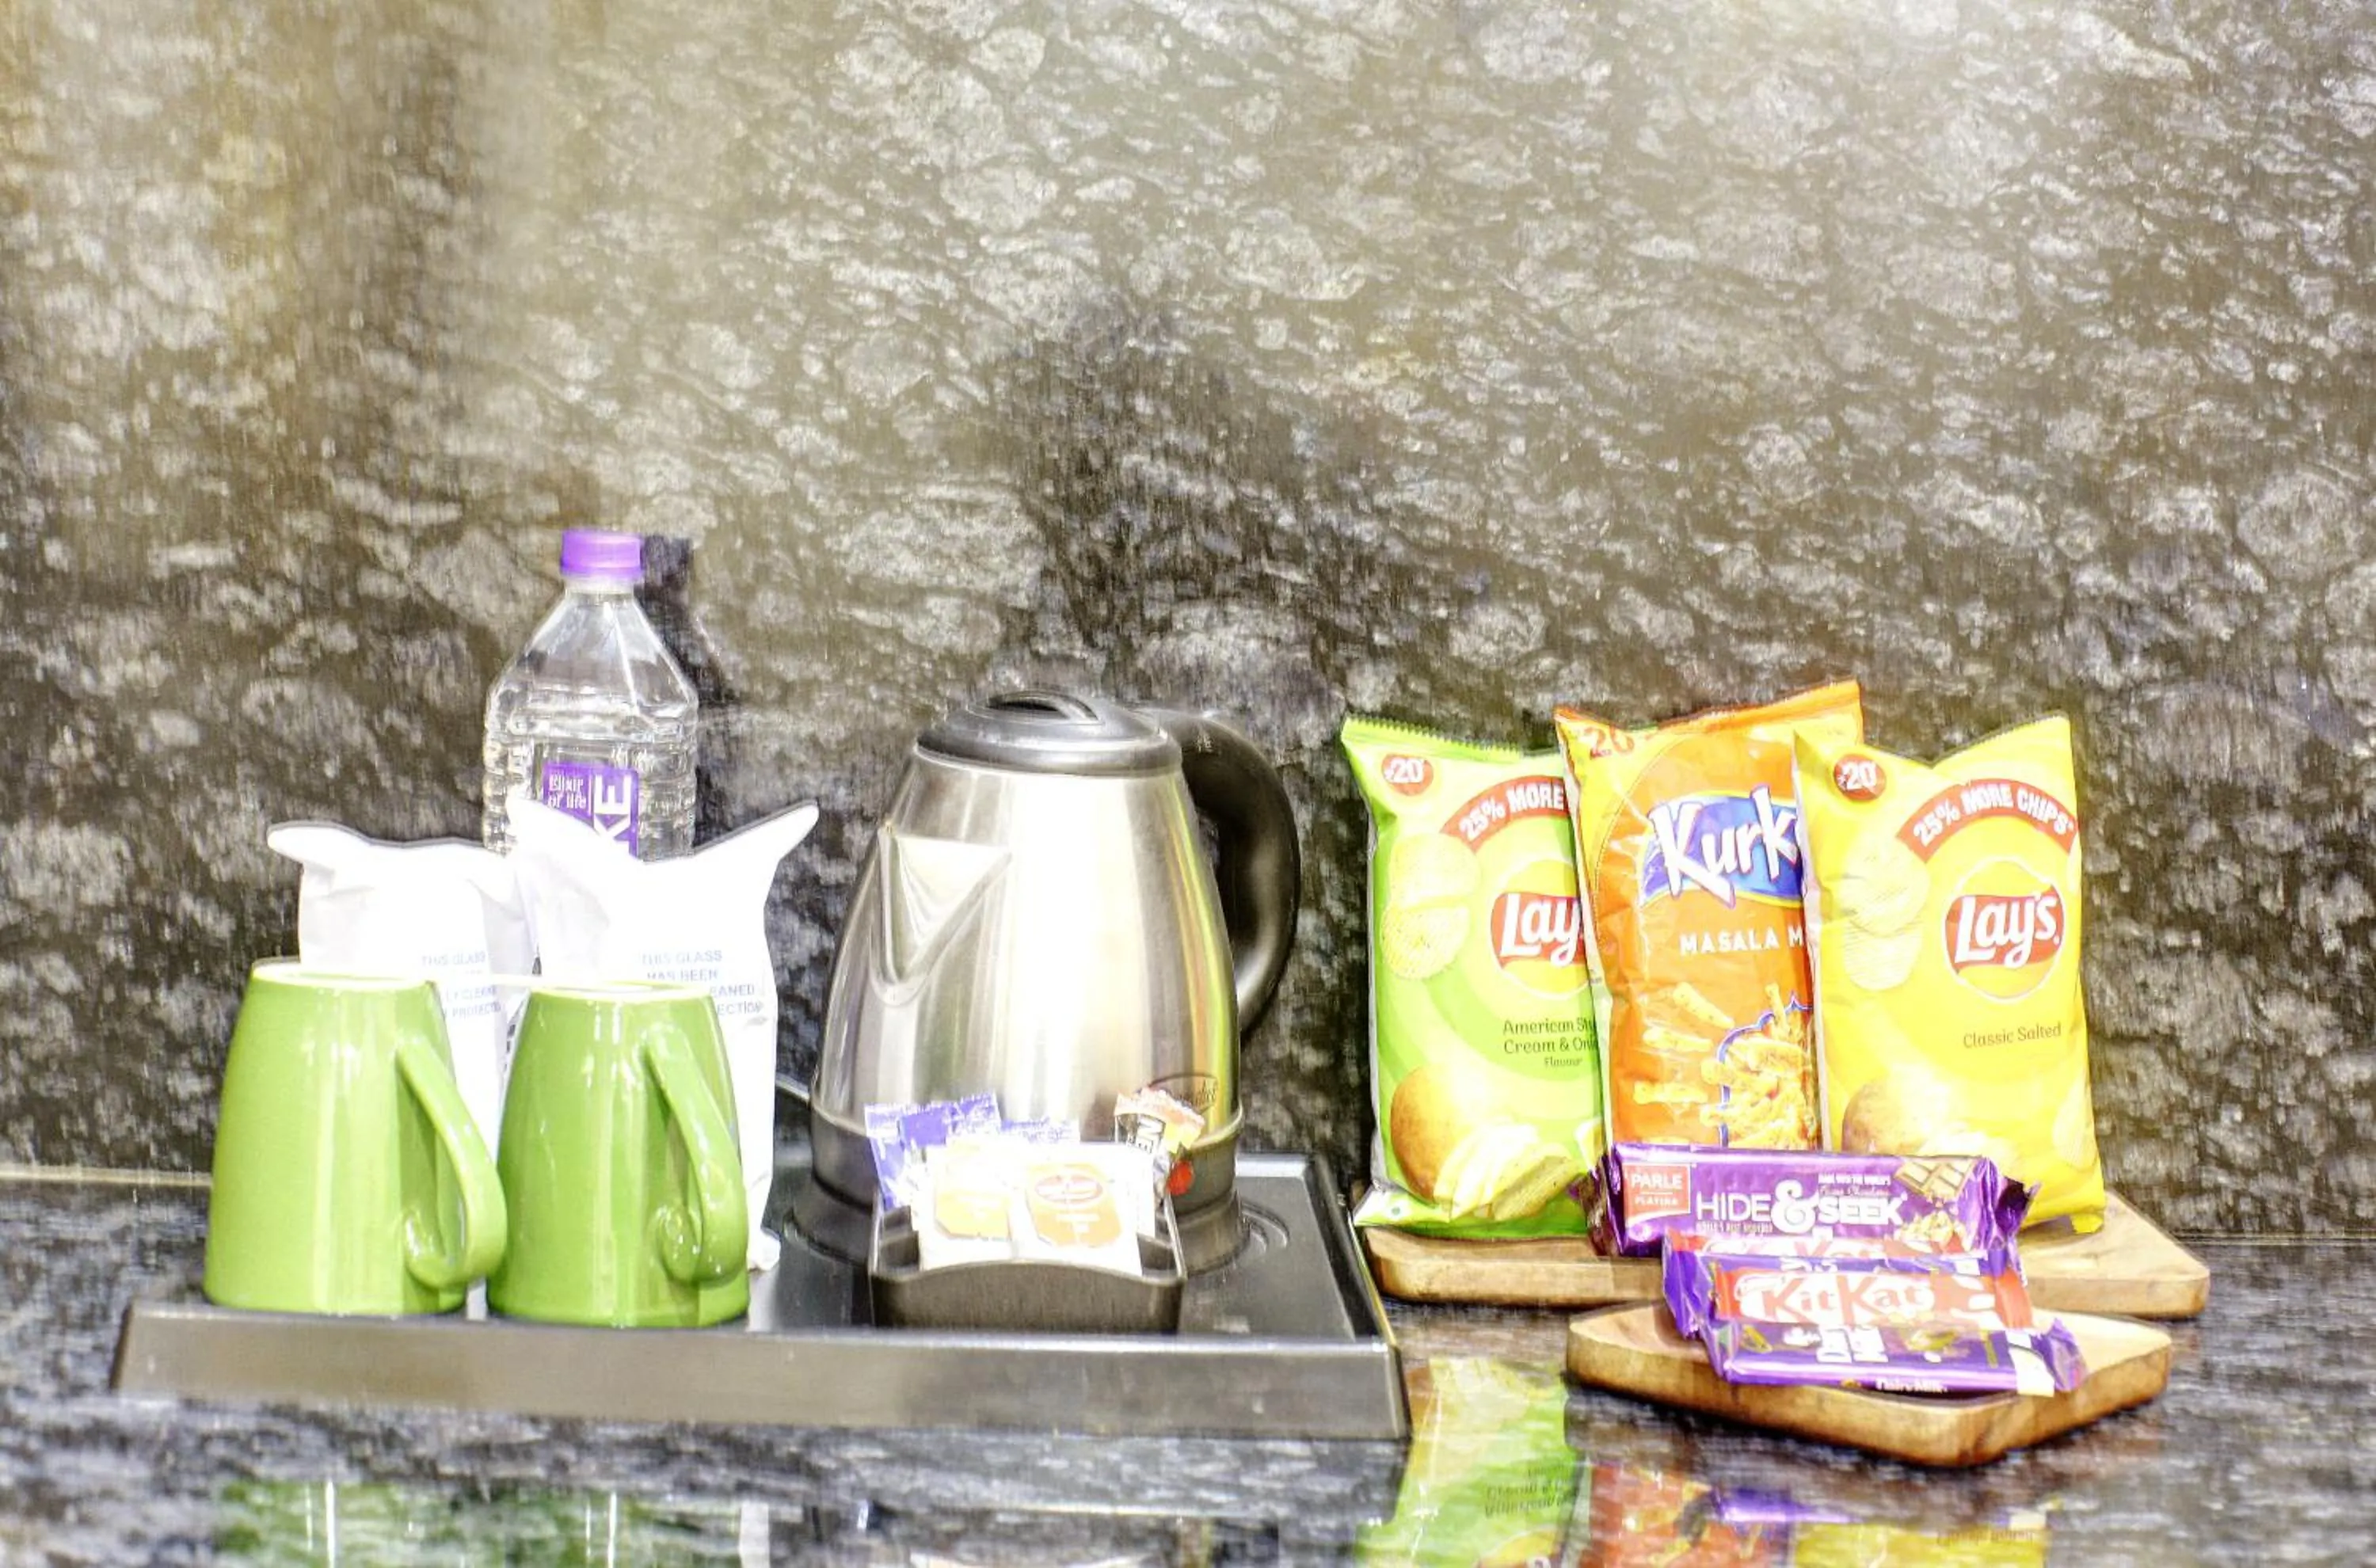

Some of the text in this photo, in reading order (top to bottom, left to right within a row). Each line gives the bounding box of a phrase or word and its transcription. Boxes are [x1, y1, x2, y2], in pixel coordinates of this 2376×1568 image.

[549, 771, 584, 792] Elixir
[1459, 782, 1564, 842] 25% MORE
[1913, 798, 1961, 847] 25%
[1960, 782, 2014, 815] MORE
[1647, 782, 1799, 909] Kurk
[1498, 892, 1584, 968] Lay
[1679, 926, 1780, 957] MASALA
[1954, 890, 2061, 969] Lay's
[676, 950, 722, 964] GLASS
[1502, 1018, 1574, 1036] American
[1504, 1038, 1555, 1054] Cream
[1559, 1037, 1570, 1052] &
[1963, 1022, 2062, 1049] Classic Salted
[1631, 1172, 1683, 1189] PARLE
[1696, 1179, 1903, 1234] HIDE & SEEK
[1761, 1274, 1919, 1328] KitKat
